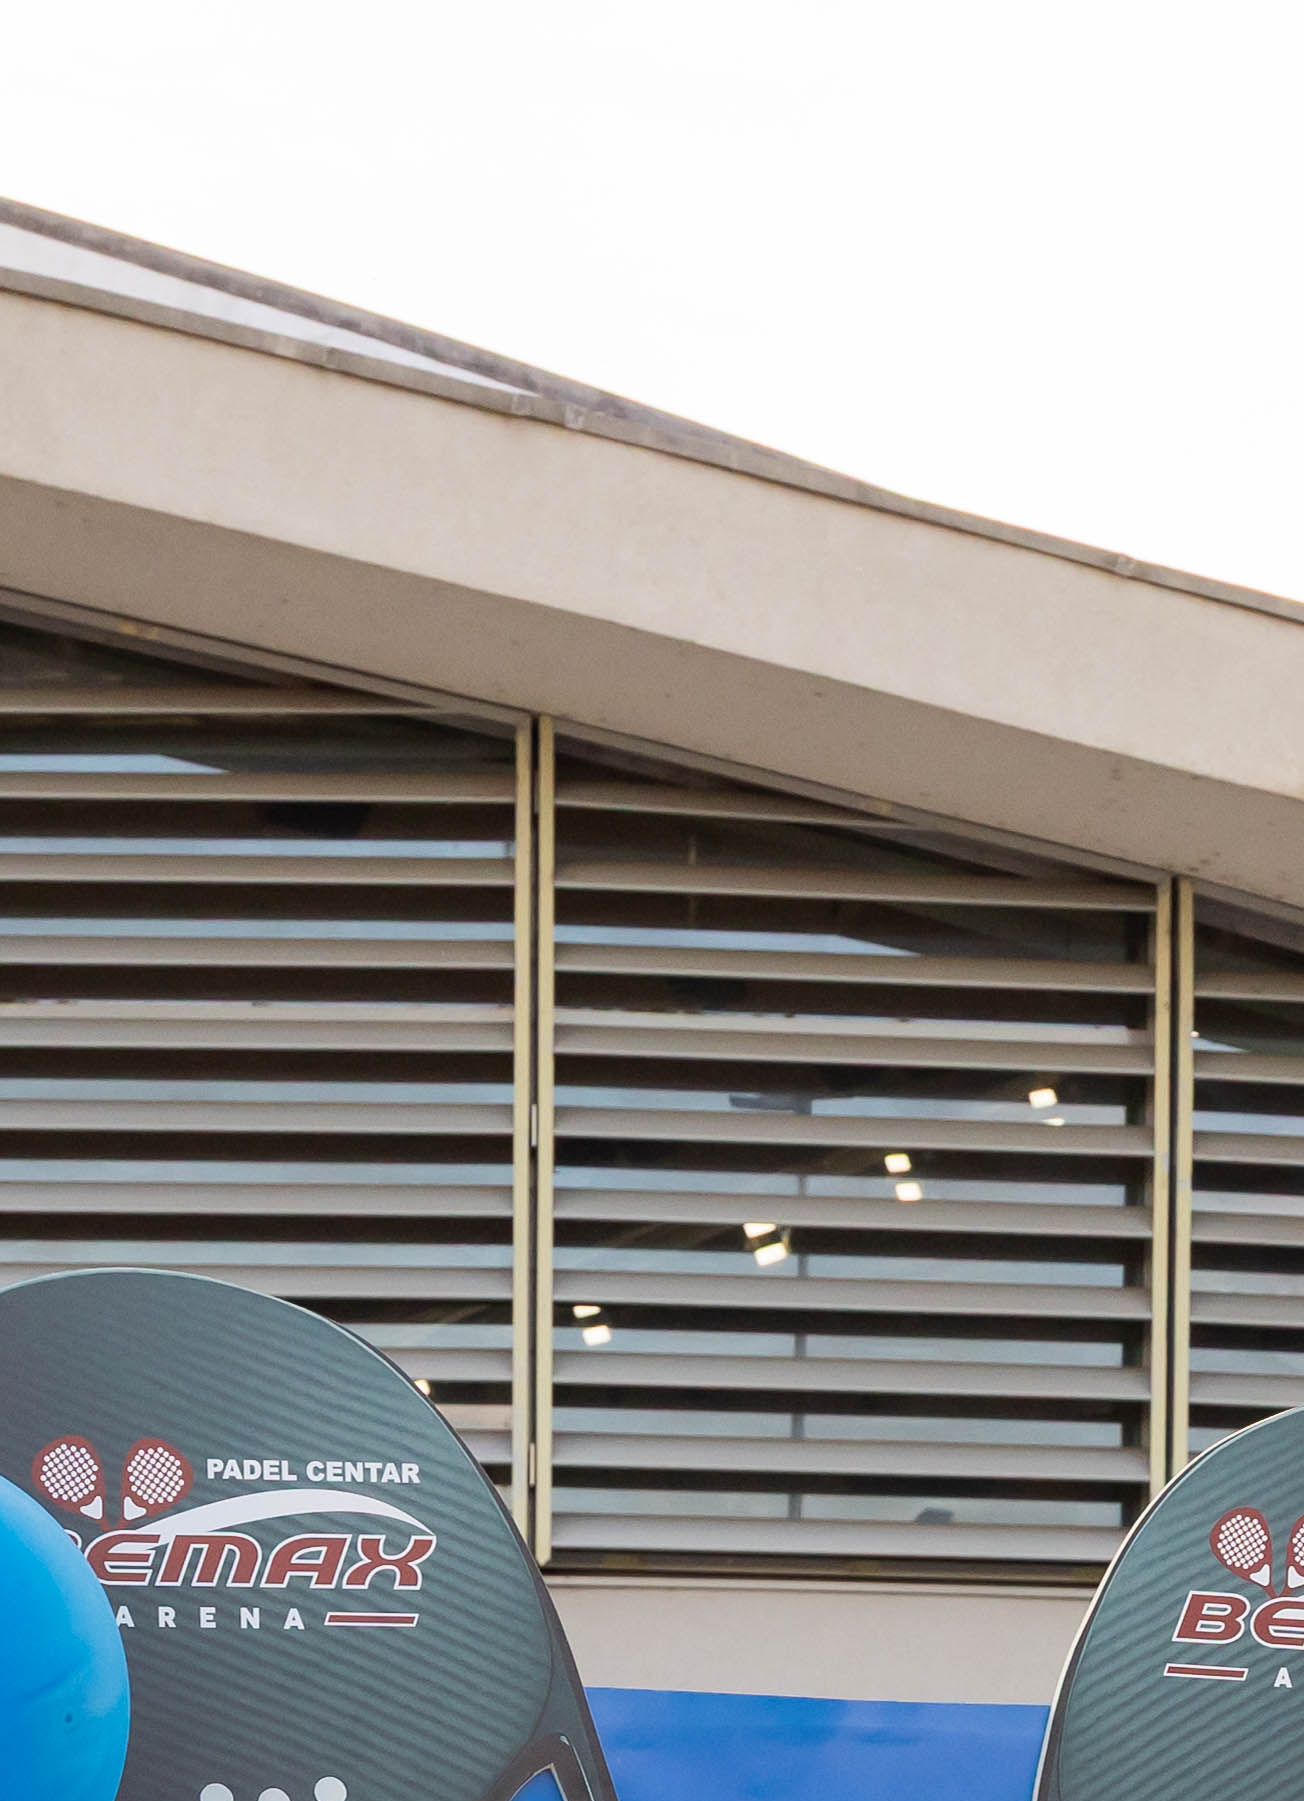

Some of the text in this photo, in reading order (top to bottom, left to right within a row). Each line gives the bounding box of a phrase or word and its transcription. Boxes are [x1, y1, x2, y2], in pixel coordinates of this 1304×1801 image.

[206, 1458, 421, 1484] PADEL CENTAR
[64, 1529, 437, 1591] EMAX
[116, 1605, 306, 1630] ARENA
